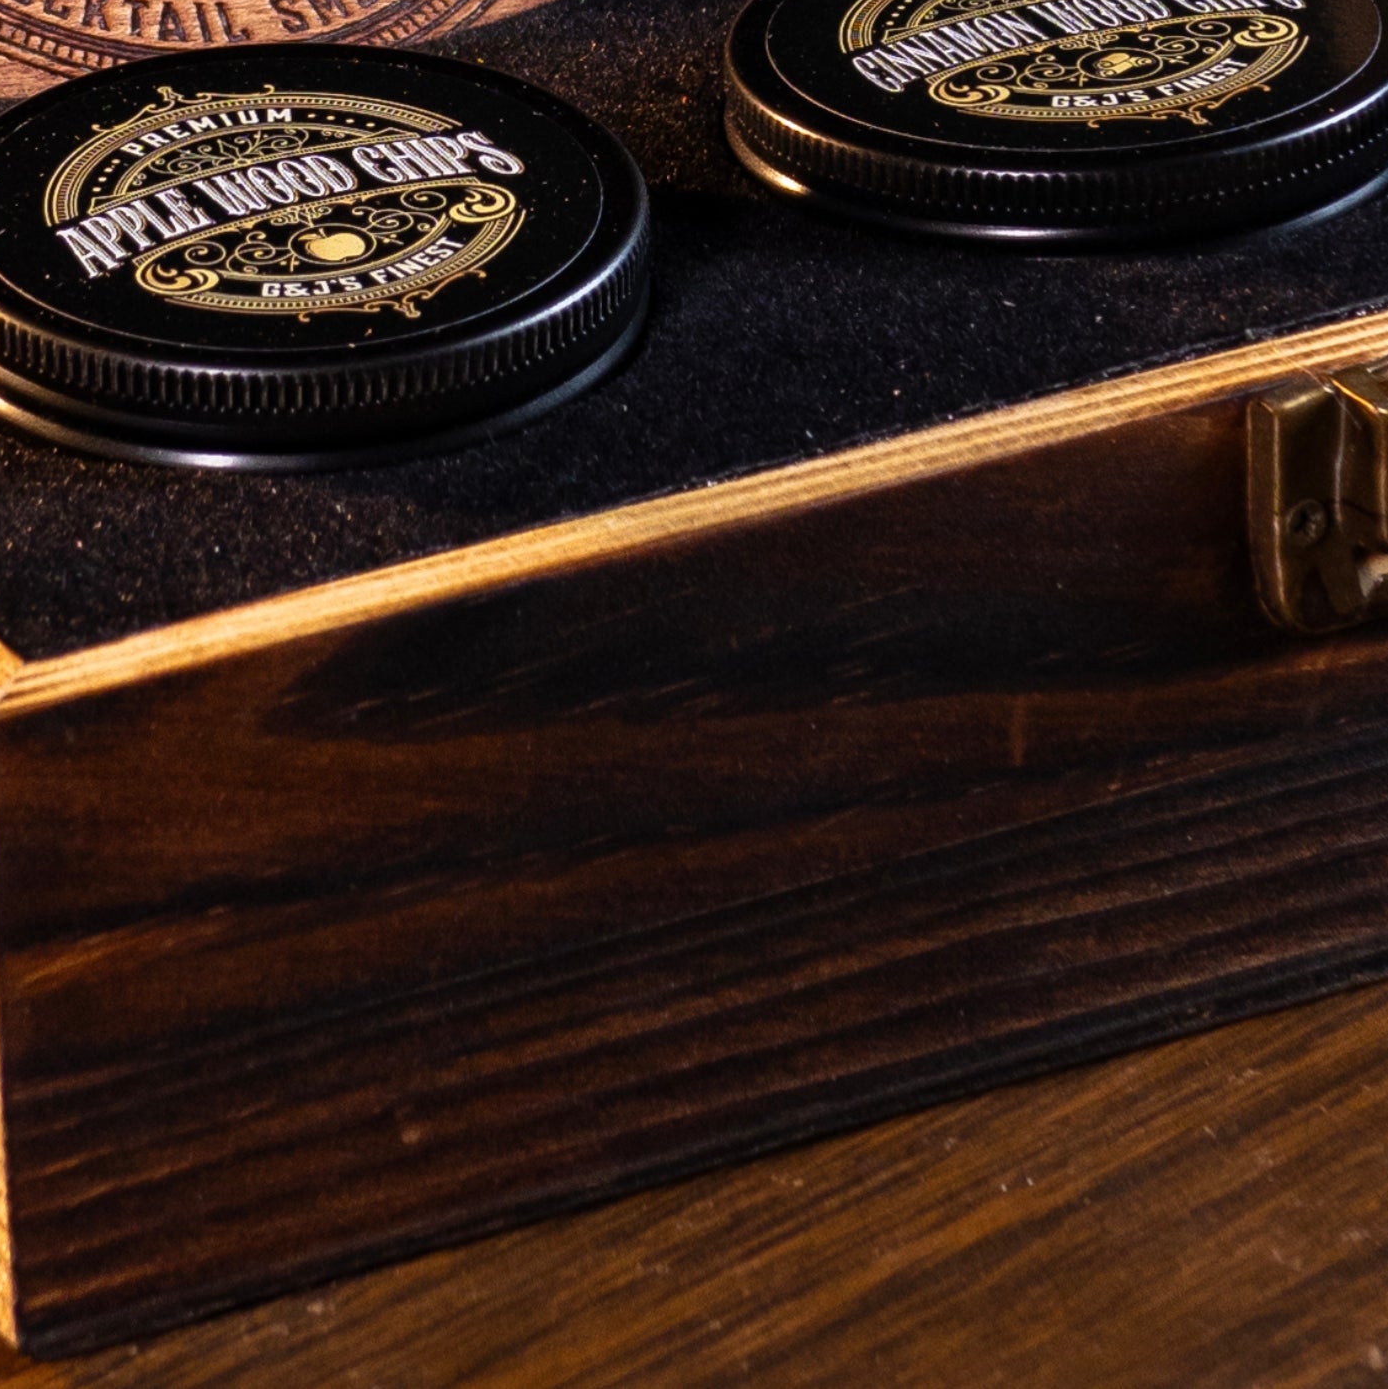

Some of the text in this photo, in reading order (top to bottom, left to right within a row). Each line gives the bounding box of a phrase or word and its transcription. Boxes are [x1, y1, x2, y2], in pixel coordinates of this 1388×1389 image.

[851, 9, 1051, 93] CINNAMON
[1051, 58, 1249, 108] G&J'S FINEST
[121, 108, 292, 157] PREMIUM
[56, 131, 525, 278] APPLE WOOD CHIPS
[260, 236, 464, 298] G&J'S FINEST
